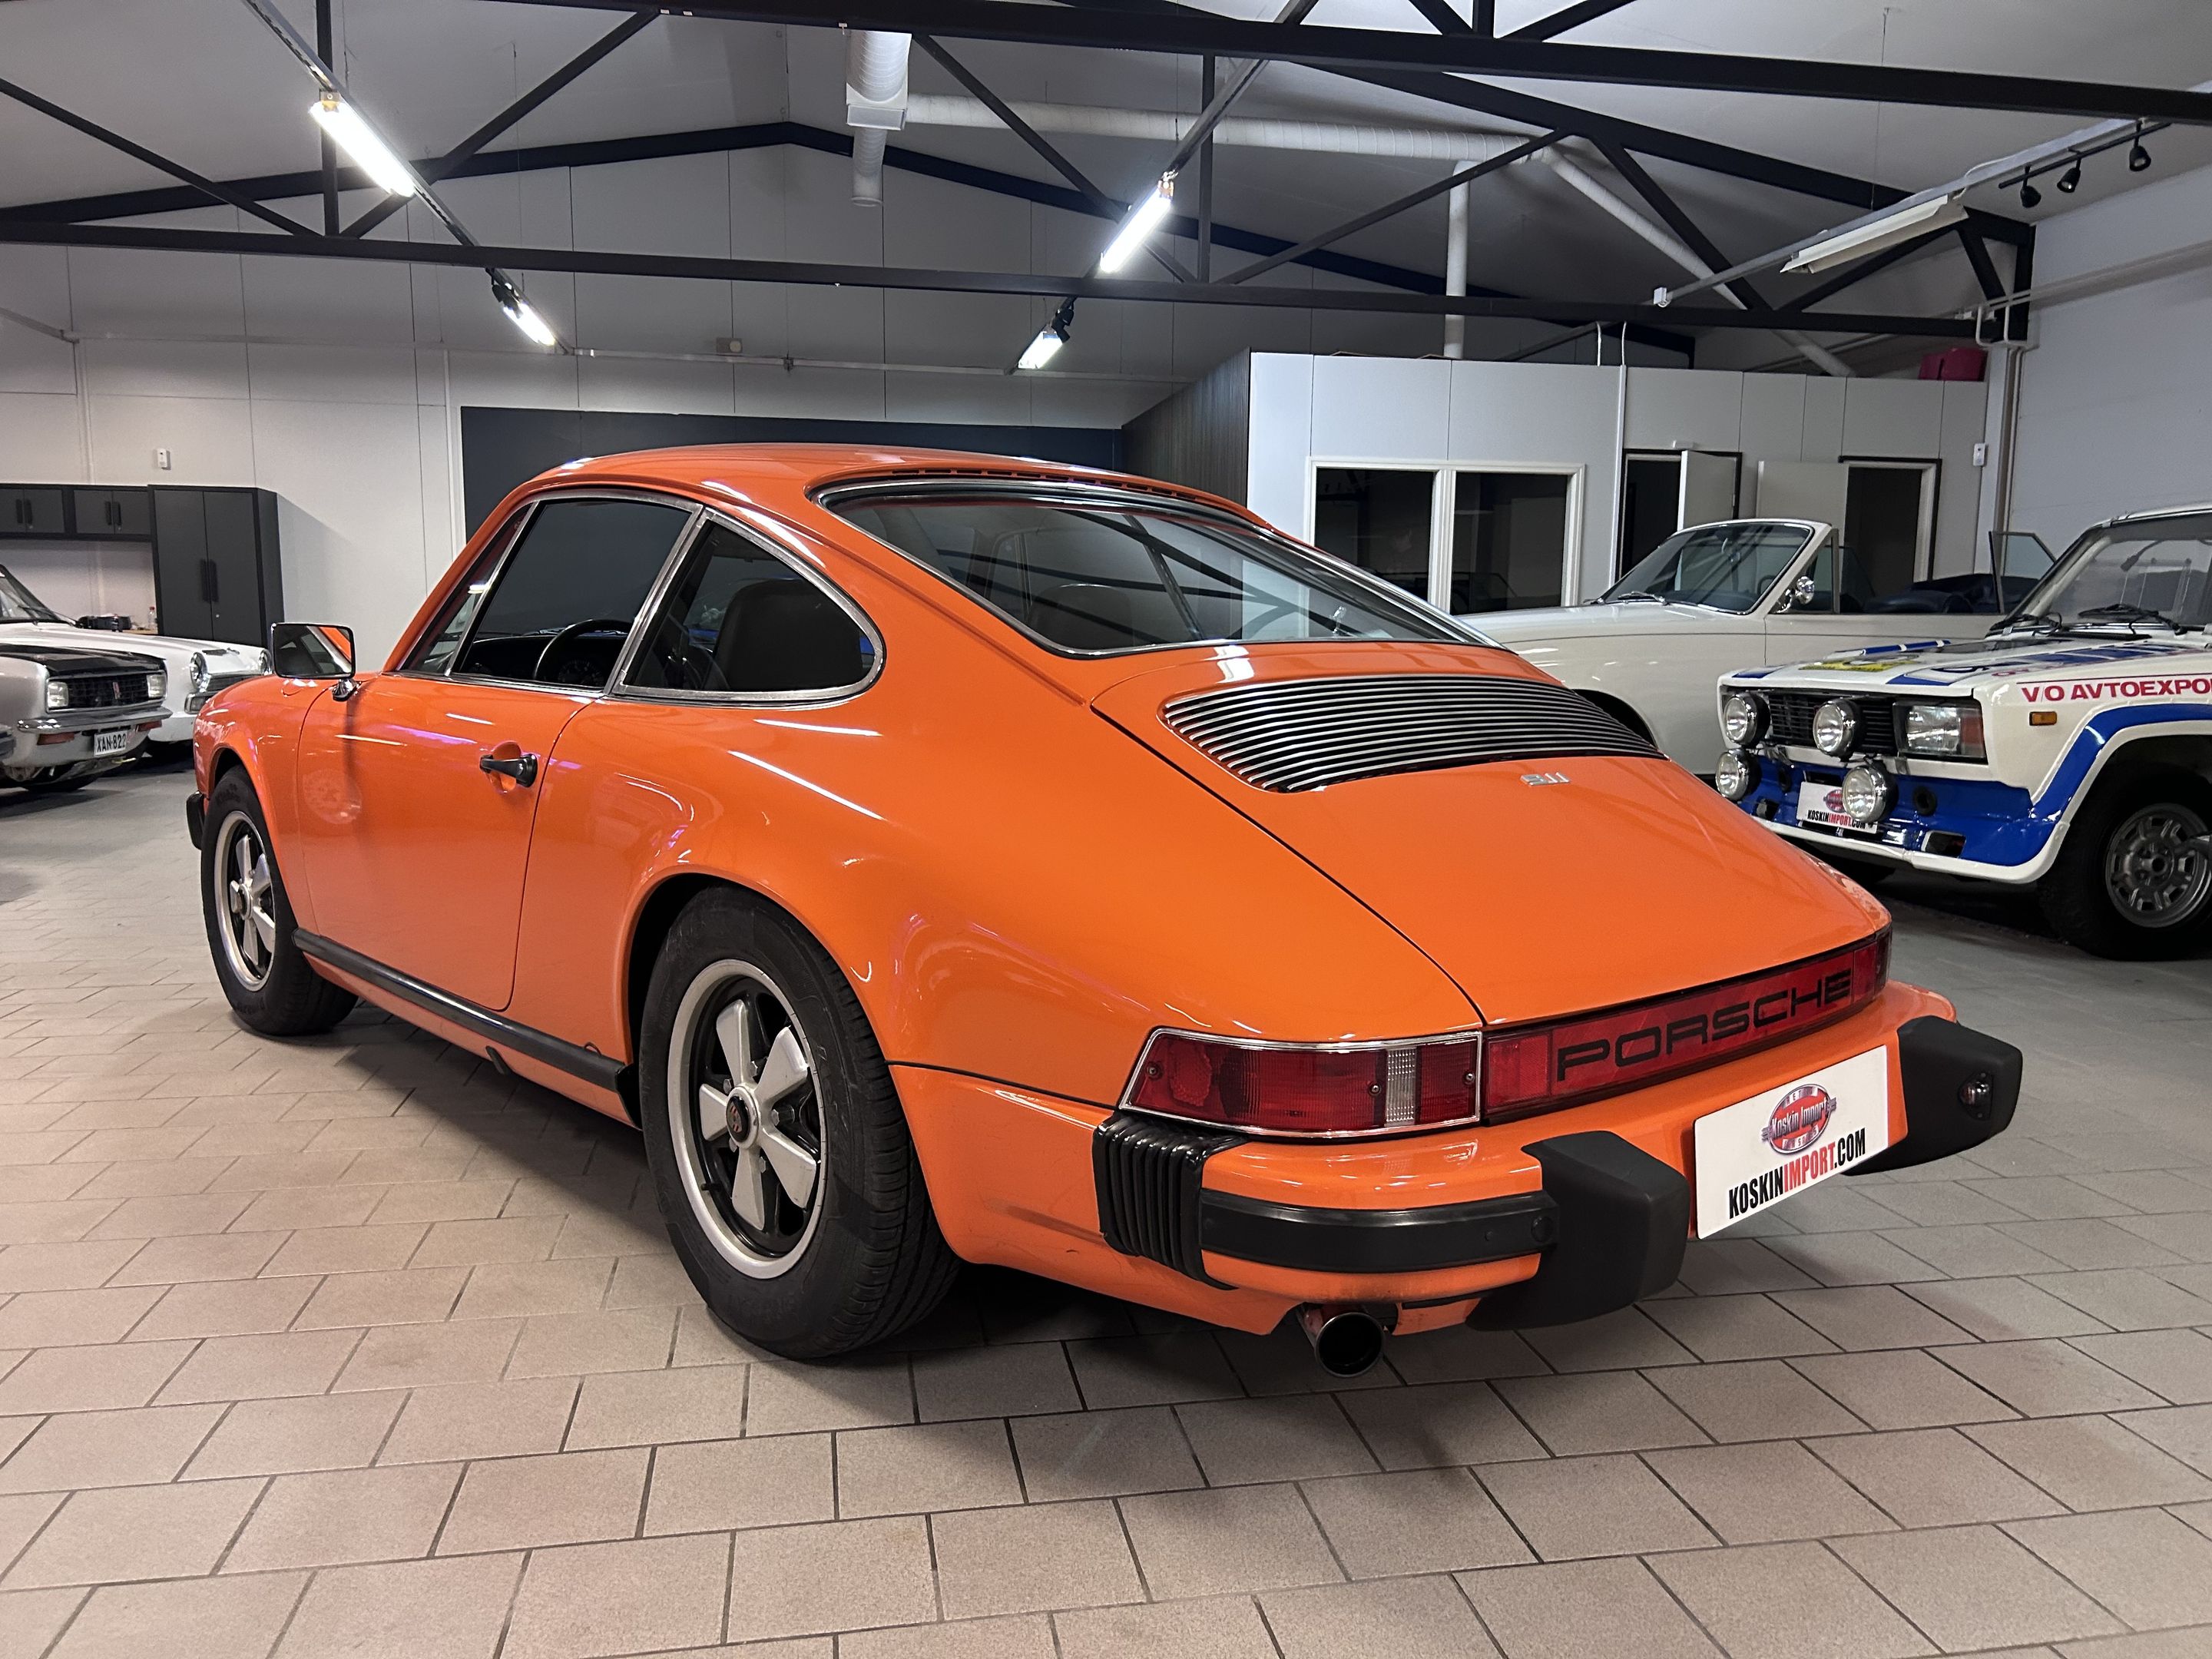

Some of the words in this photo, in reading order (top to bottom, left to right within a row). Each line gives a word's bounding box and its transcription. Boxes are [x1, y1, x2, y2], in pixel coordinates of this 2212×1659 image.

[2071, 678, 2212, 700] AVTOEXPO
[97, 733, 126, 752] XAN-822
[1557, 970, 1852, 1081] PORSCHE
[1771, 1111, 1799, 1138] Koskin
[1801, 1096, 1827, 1128] Import
[1729, 1128, 1866, 1220] KOSKINIMPORT.COM
